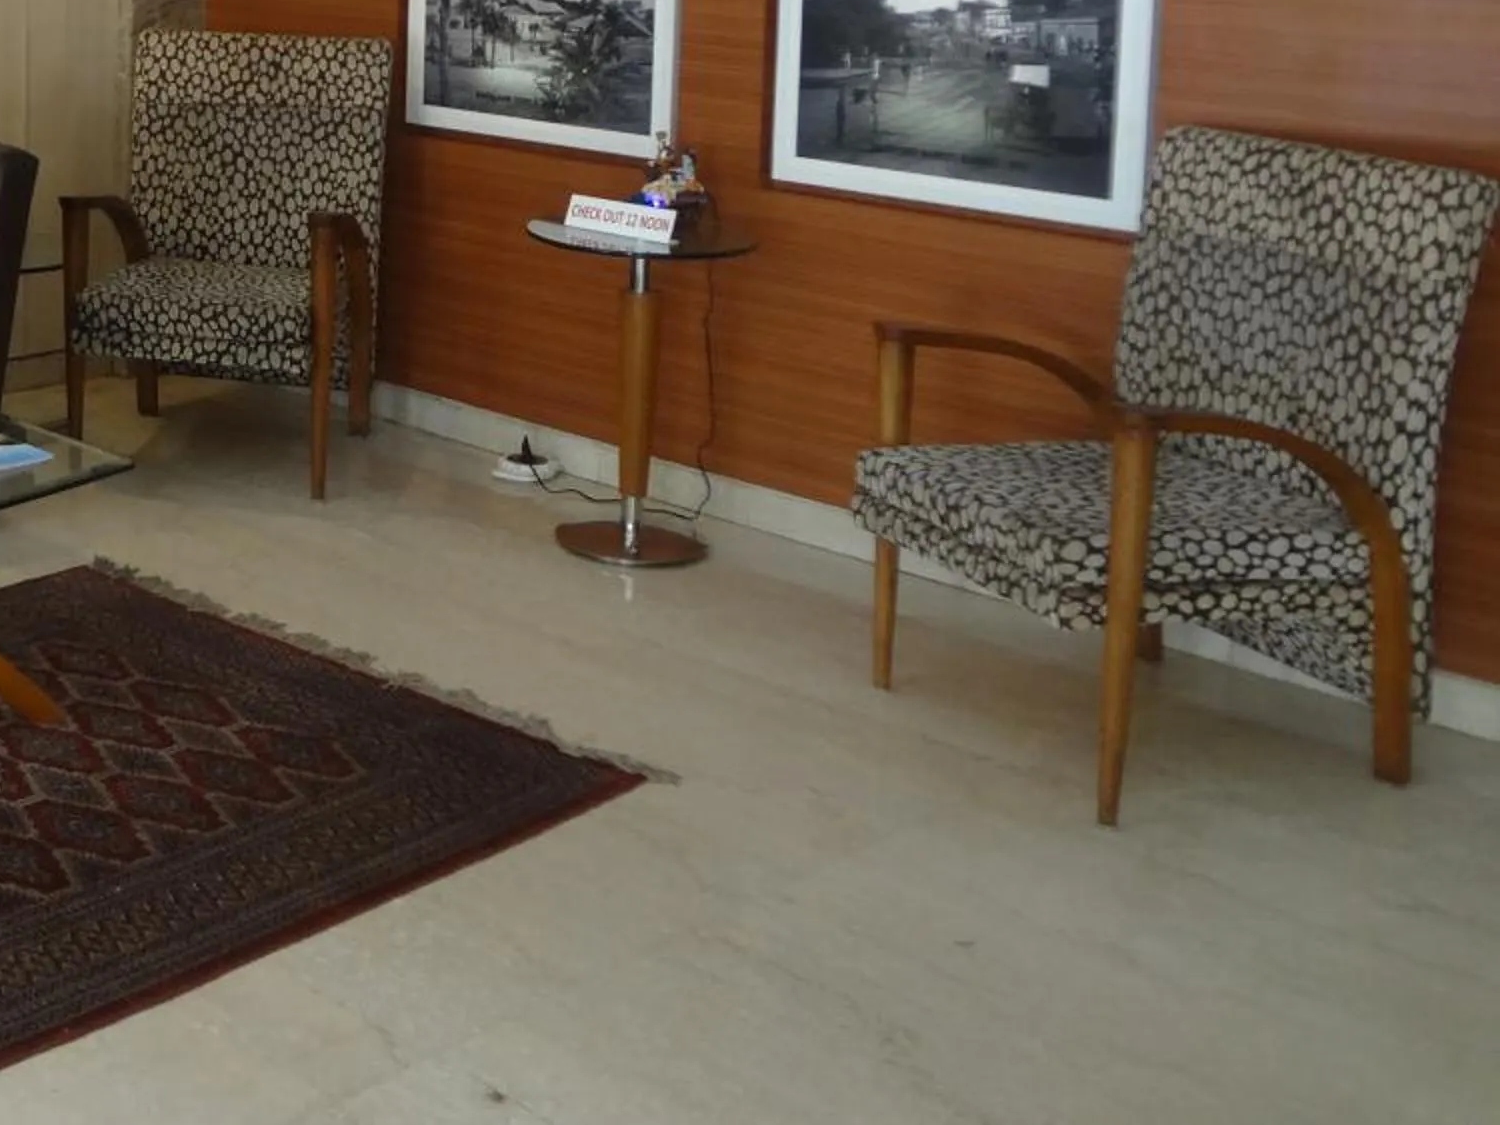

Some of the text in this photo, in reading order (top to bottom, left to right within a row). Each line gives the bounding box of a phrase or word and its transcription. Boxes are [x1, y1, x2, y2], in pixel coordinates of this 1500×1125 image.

[571, 203, 671, 232] CHECK OUT 12 NOON
